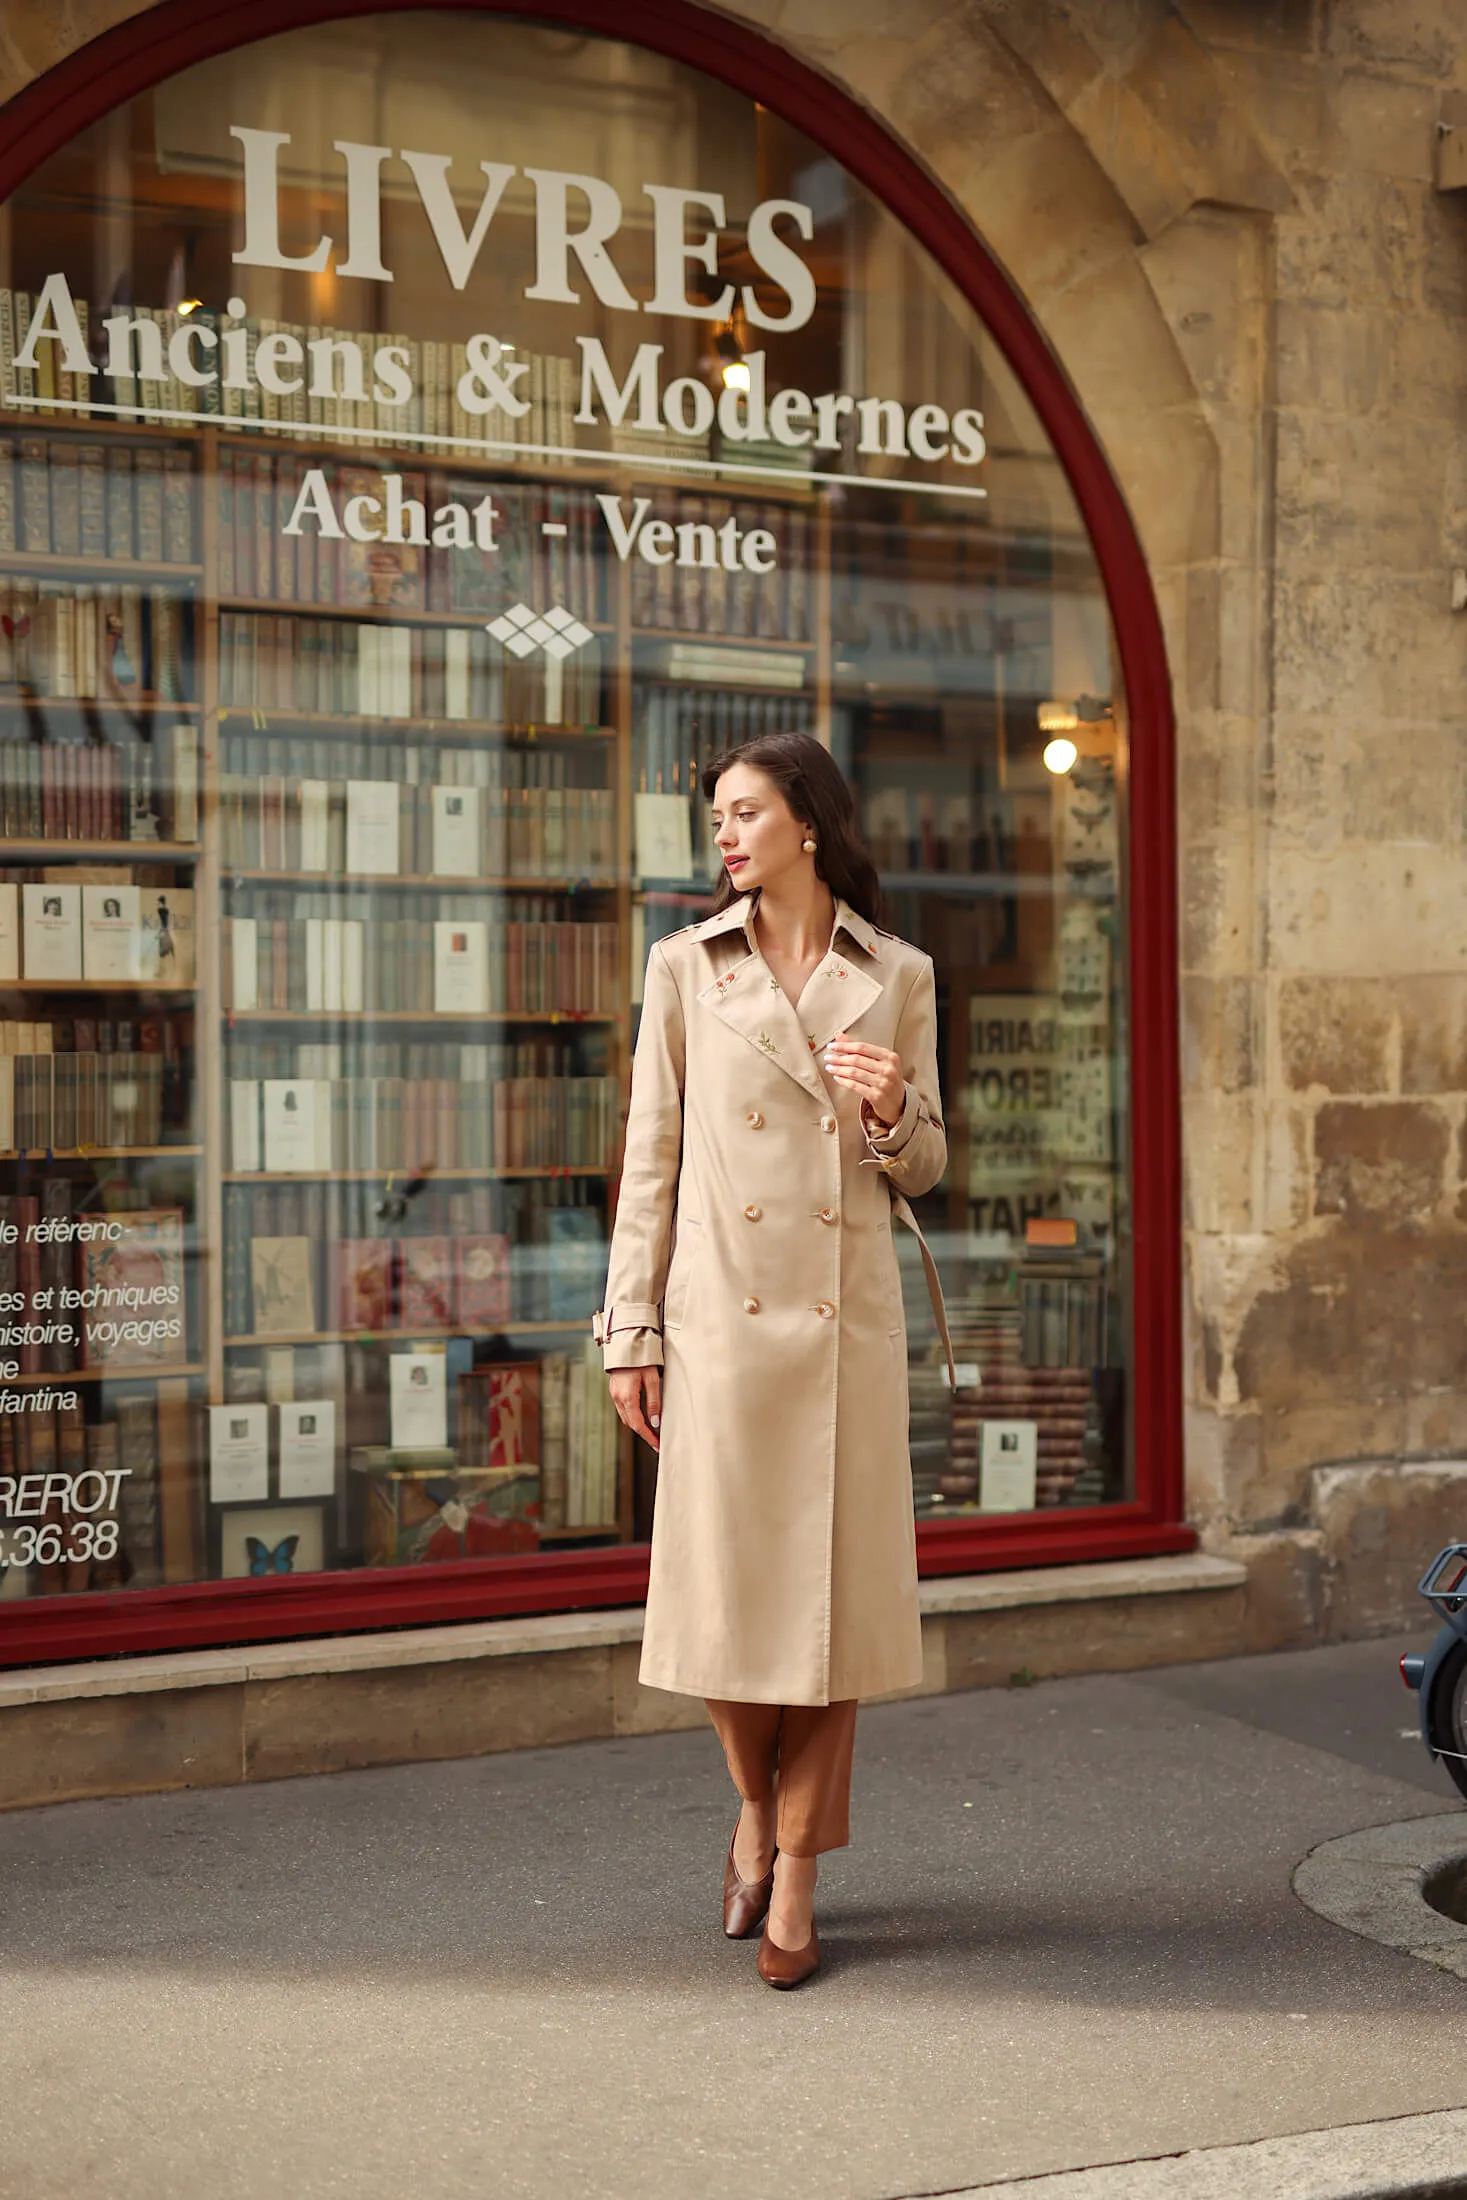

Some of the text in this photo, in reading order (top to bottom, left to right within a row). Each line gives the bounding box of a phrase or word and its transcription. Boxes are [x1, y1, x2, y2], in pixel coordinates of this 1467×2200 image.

[229, 125, 817, 333] LIVRES
[12, 272, 414, 406] Anciens
[457, 333, 532, 418] &
[573, 336, 986, 466] Modernes
[282, 469, 499, 551] Achat
[595, 494, 777, 573] Vente
[32, 1286, 55, 1310] et
[60, 1281, 180, 1312] techniques
[86, 1318, 182, 1347] voyages
[0, 1519, 119, 1568] .36.38
